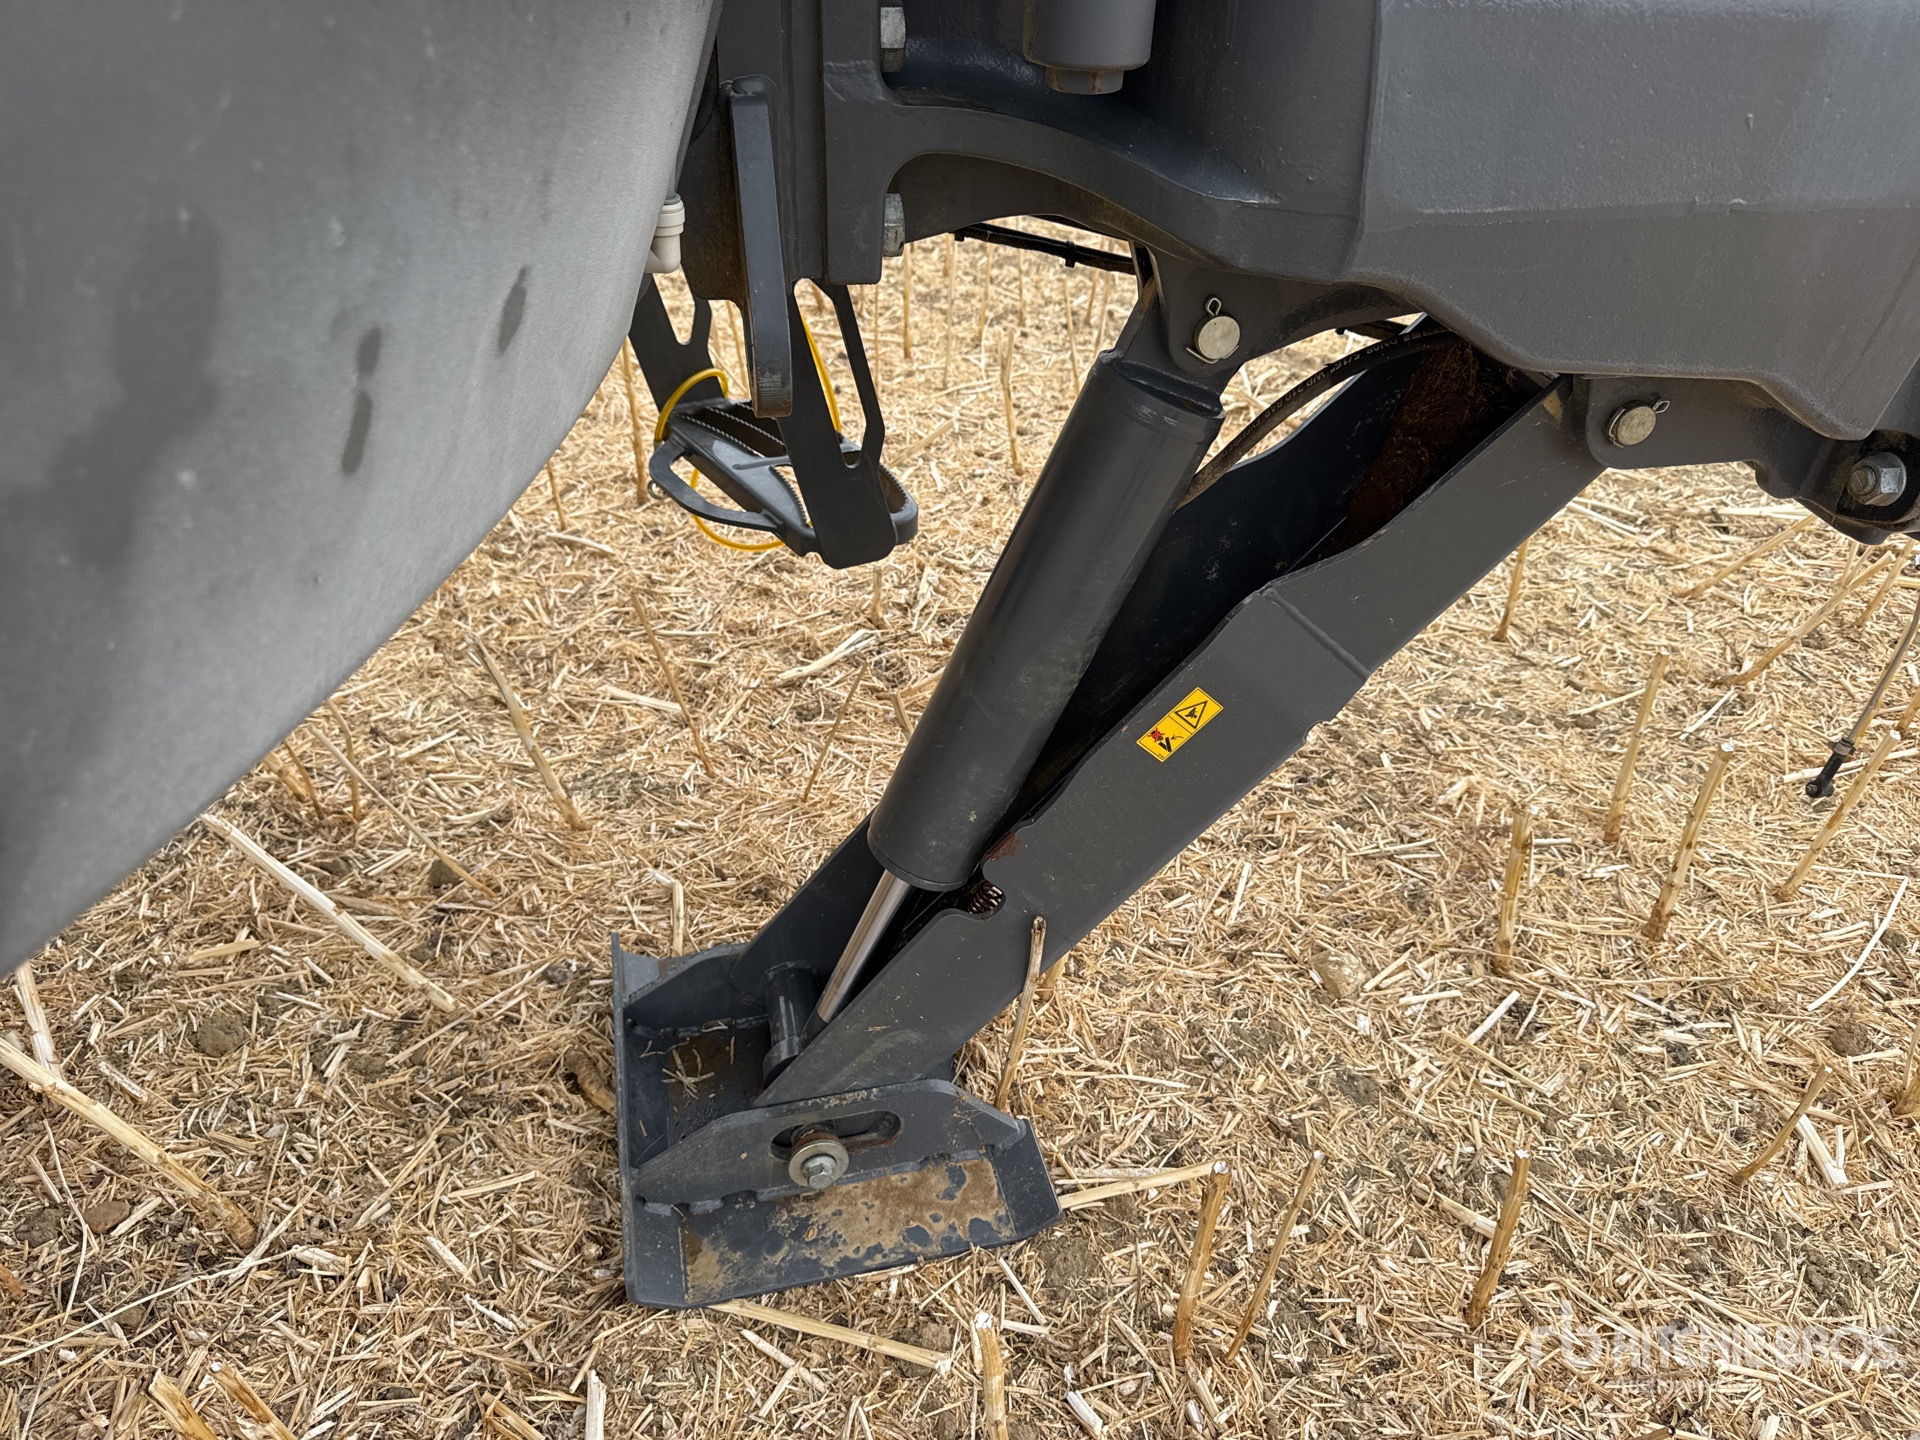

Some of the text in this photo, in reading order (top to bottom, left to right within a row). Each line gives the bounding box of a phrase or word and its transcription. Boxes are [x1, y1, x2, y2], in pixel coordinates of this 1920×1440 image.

[1366, 338, 1398, 355] DN08
[1306, 372, 1326, 387] WP
[1285, 387, 1304, 401] 210
[1264, 401, 1284, 418] BAR
